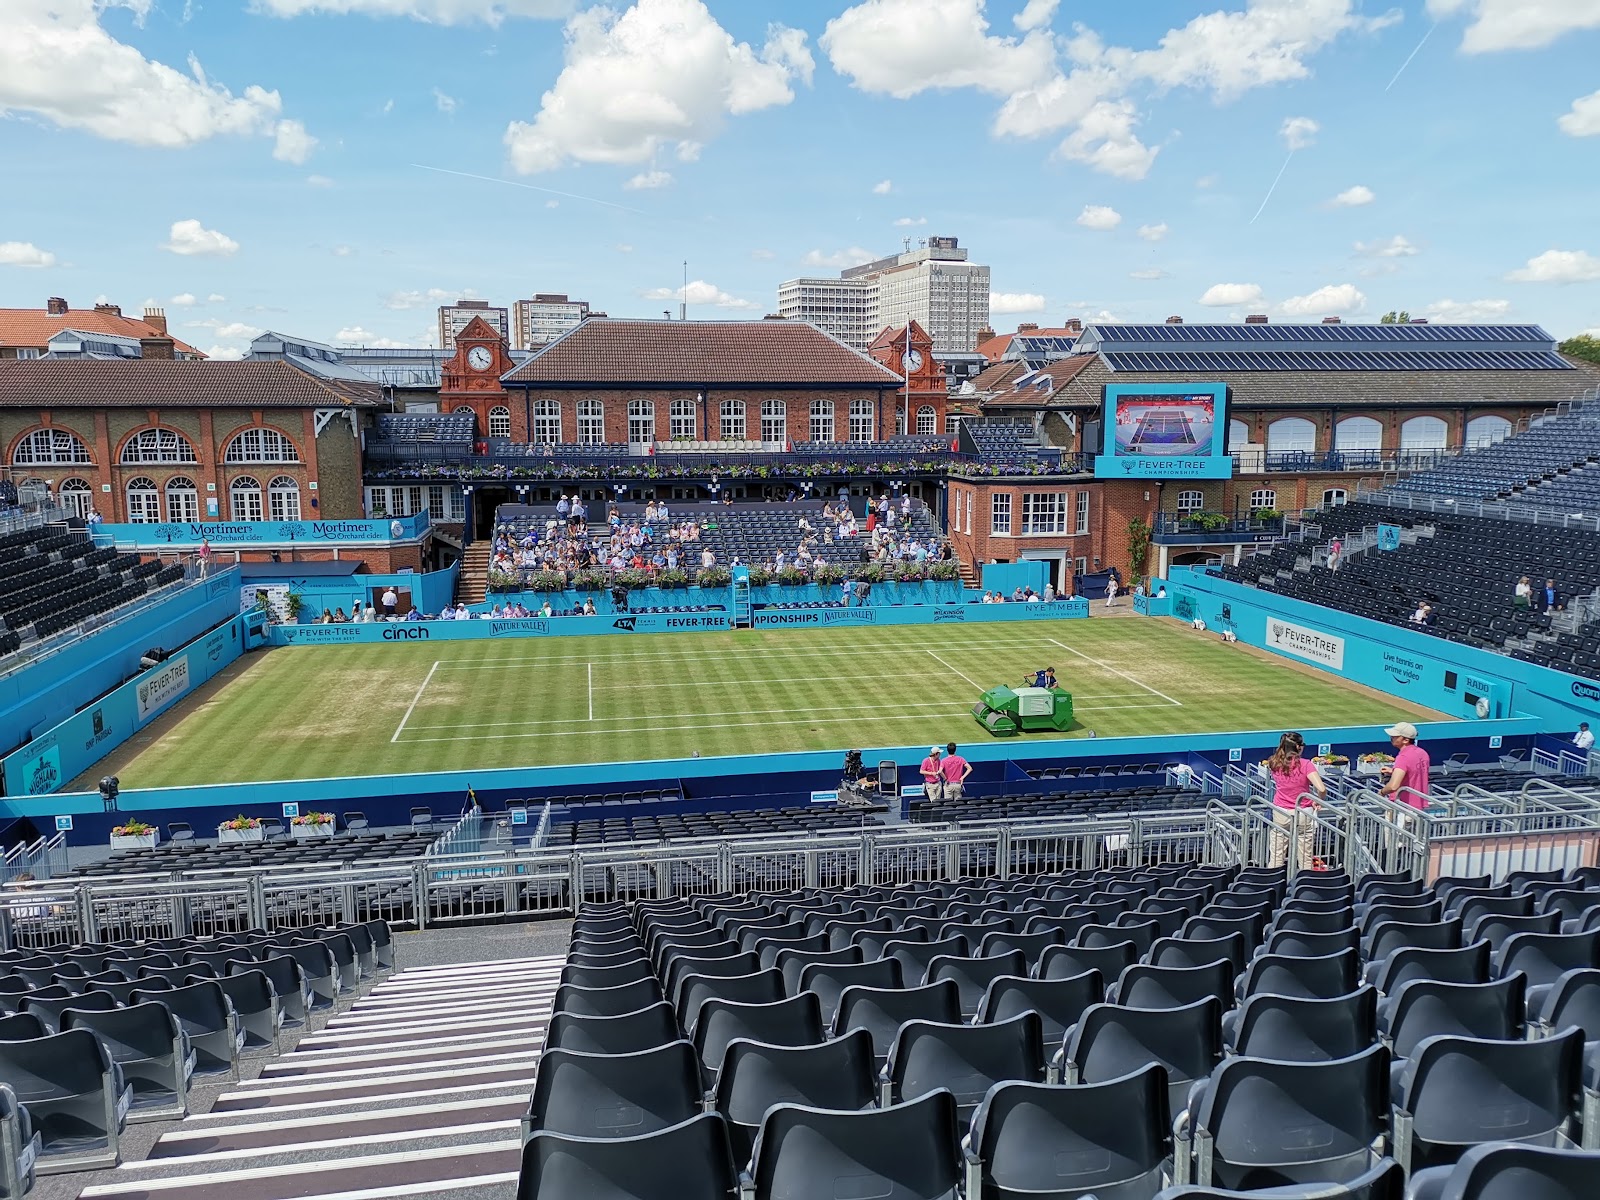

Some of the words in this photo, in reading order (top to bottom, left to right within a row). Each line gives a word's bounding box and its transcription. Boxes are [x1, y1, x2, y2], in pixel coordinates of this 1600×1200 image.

[1138, 460, 1206, 469] FEVER-TREE
[190, 523, 253, 539] Mortimers
[313, 521, 373, 538] Mortimers
[337, 532, 366, 540] Orchard
[1025, 602, 1088, 612] NYETIMBER
[666, 617, 725, 627] FEVER-TREE
[824, 610, 850, 622] NATURE
[851, 610, 874, 621] VALLEY
[299, 627, 361, 637] FEVER-TREE
[382, 624, 429, 640] cinch
[492, 622, 520, 634] NATURE
[521, 621, 547, 632] VALLEY
[617, 620, 634, 630] LTA
[1285, 627, 1337, 654] FEVER-TREE
[1289, 642, 1331, 660] CHAMPIONSHIPS
[1383, 651, 1395, 663] Live
[1396, 656, 1414, 668] tennis
[149, 662, 187, 696] FEVER-TREE
[1384, 664, 1402, 675] prime
[1403, 669, 1420, 681] video
[1466, 677, 1489, 693] RADO
[29, 768, 58, 795] HIGHLAND
